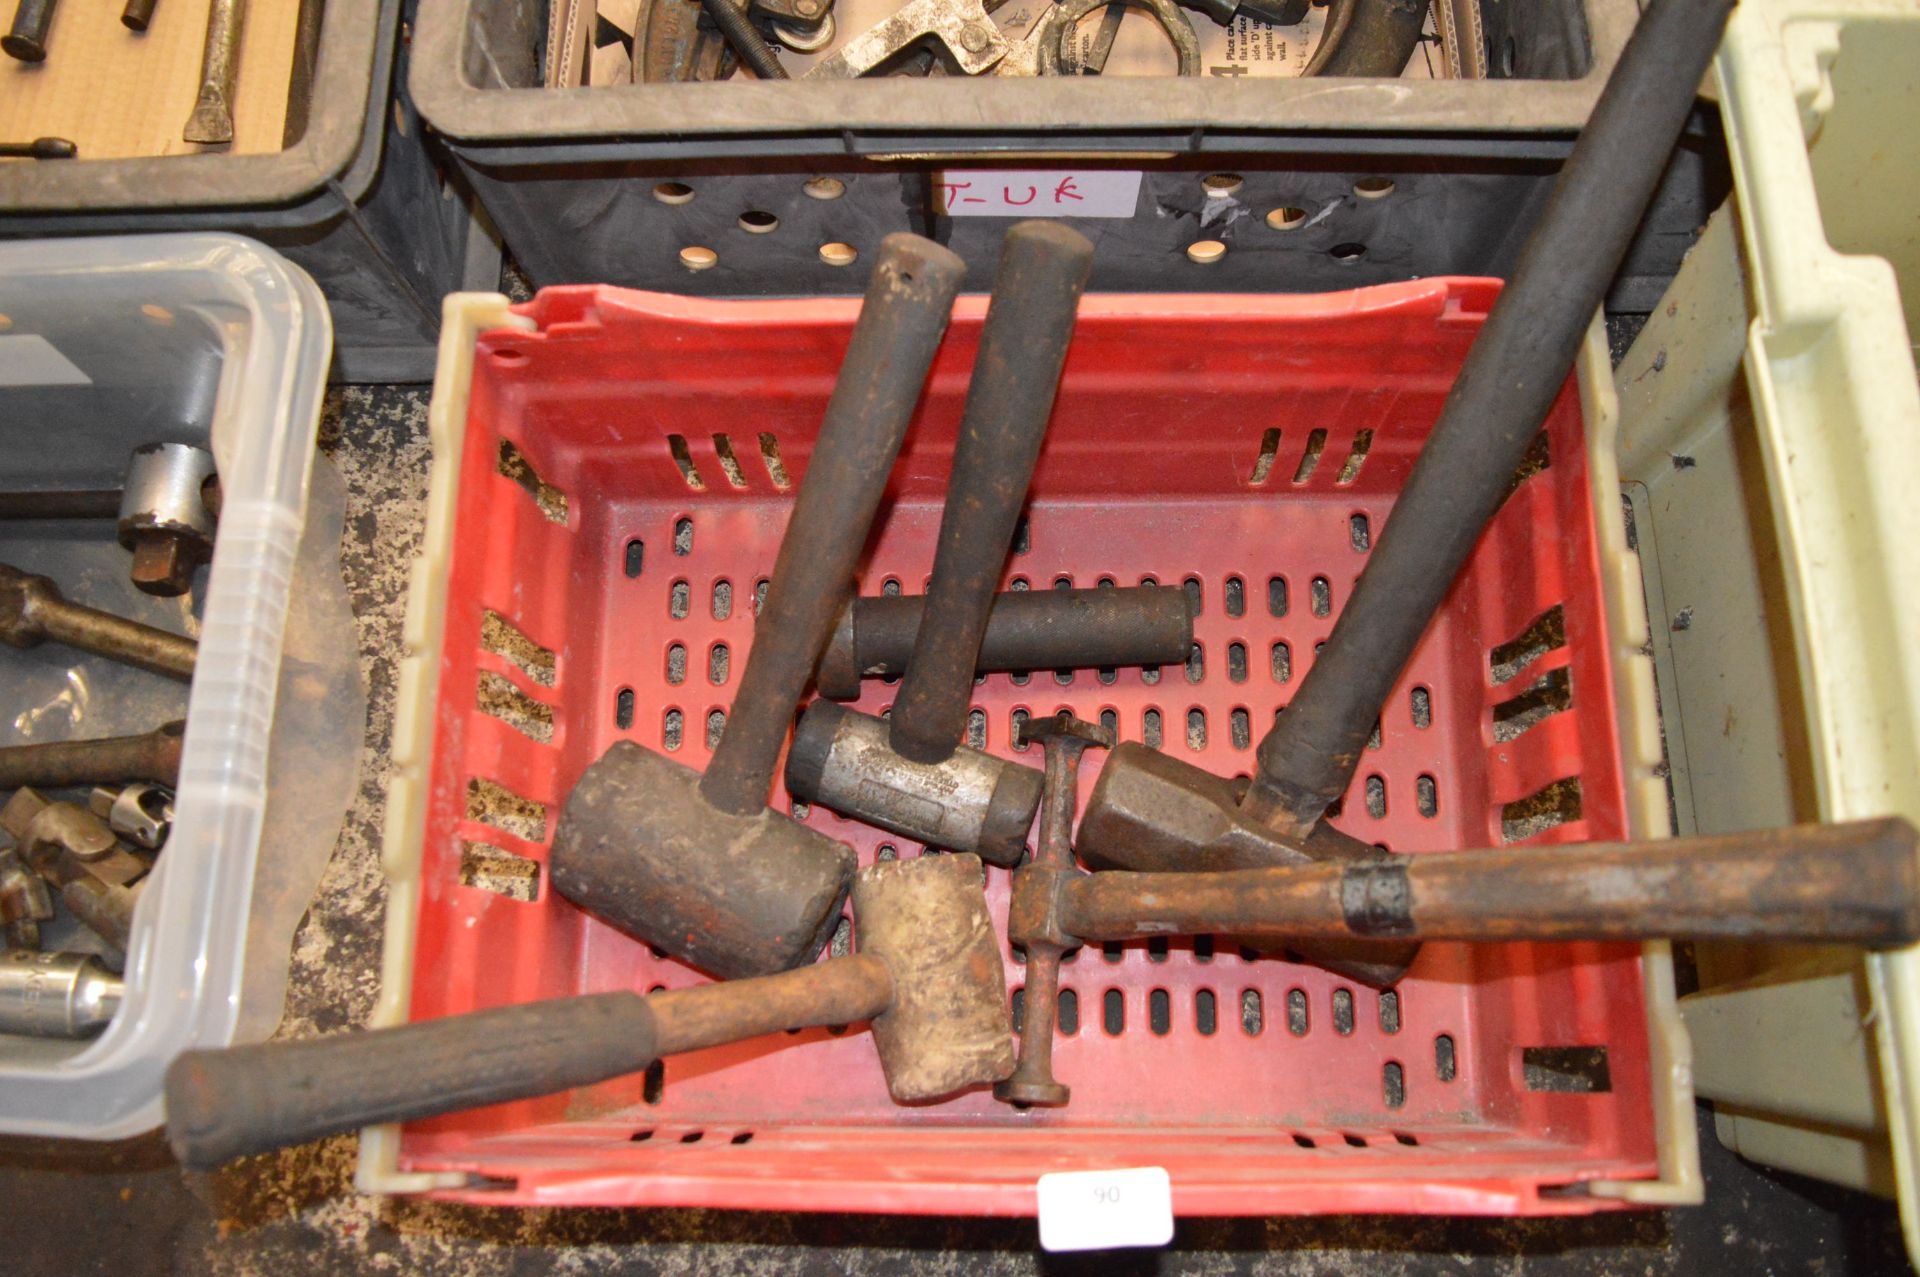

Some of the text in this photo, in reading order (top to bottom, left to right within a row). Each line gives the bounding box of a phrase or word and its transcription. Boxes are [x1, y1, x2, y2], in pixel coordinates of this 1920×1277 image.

[1226, 39, 1235, 61] Place
[1238, 17, 1248, 61] flat surface
[1264, 31, 1275, 61] against
[1252, 44, 1260, 61] side
[1094, 1185, 1121, 1205] 90
